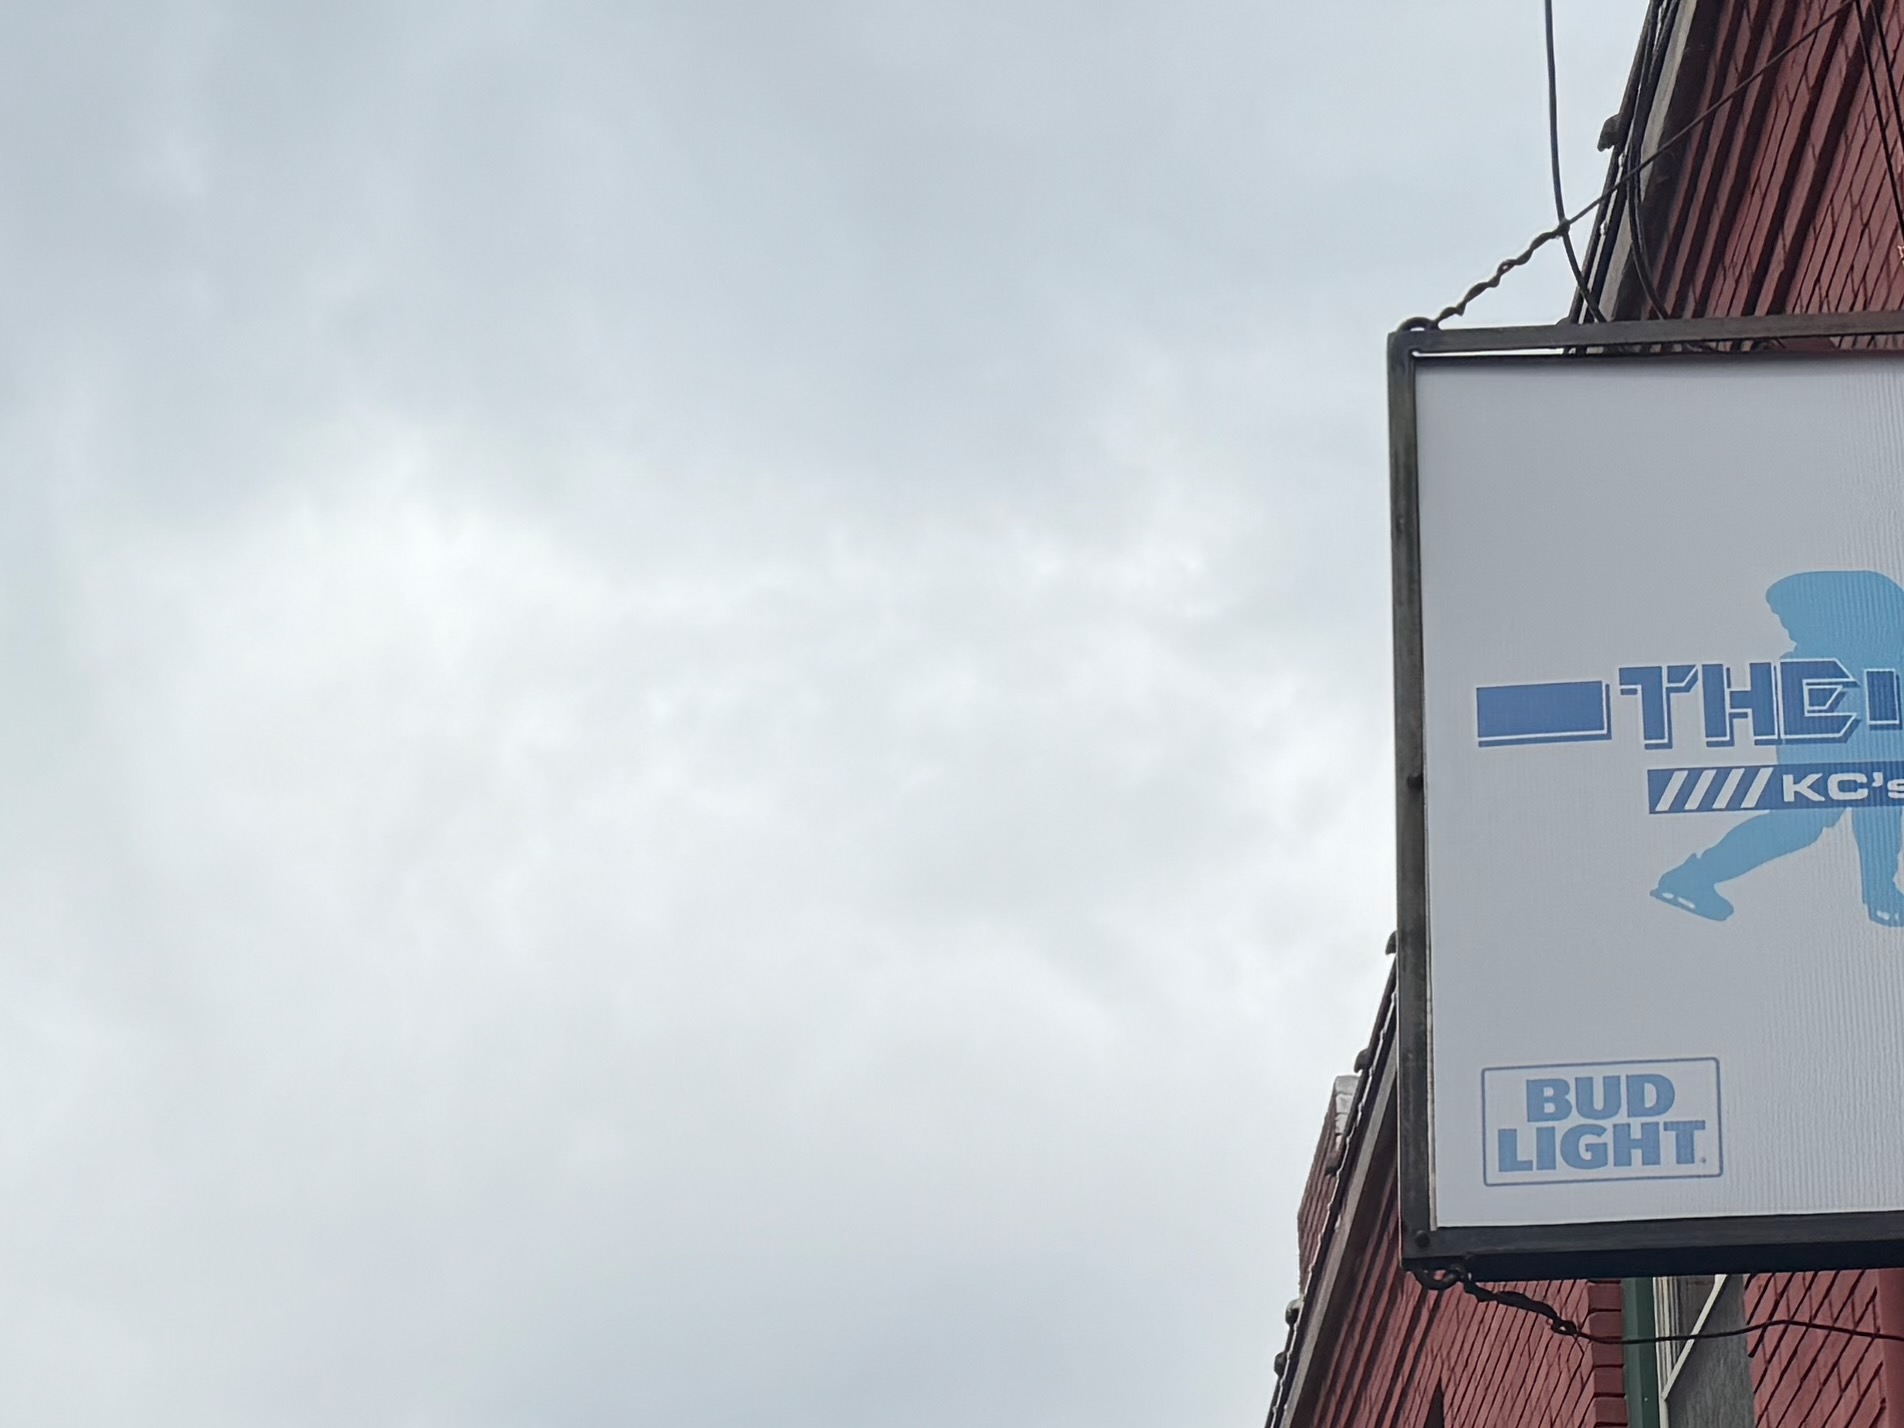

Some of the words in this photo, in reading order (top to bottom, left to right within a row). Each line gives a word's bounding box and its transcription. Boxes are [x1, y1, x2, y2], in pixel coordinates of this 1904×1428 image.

[1617, 657, 1861, 750] THE
[1526, 1073, 1676, 1123] BUD
[1497, 1119, 1707, 1173] LIGHT
